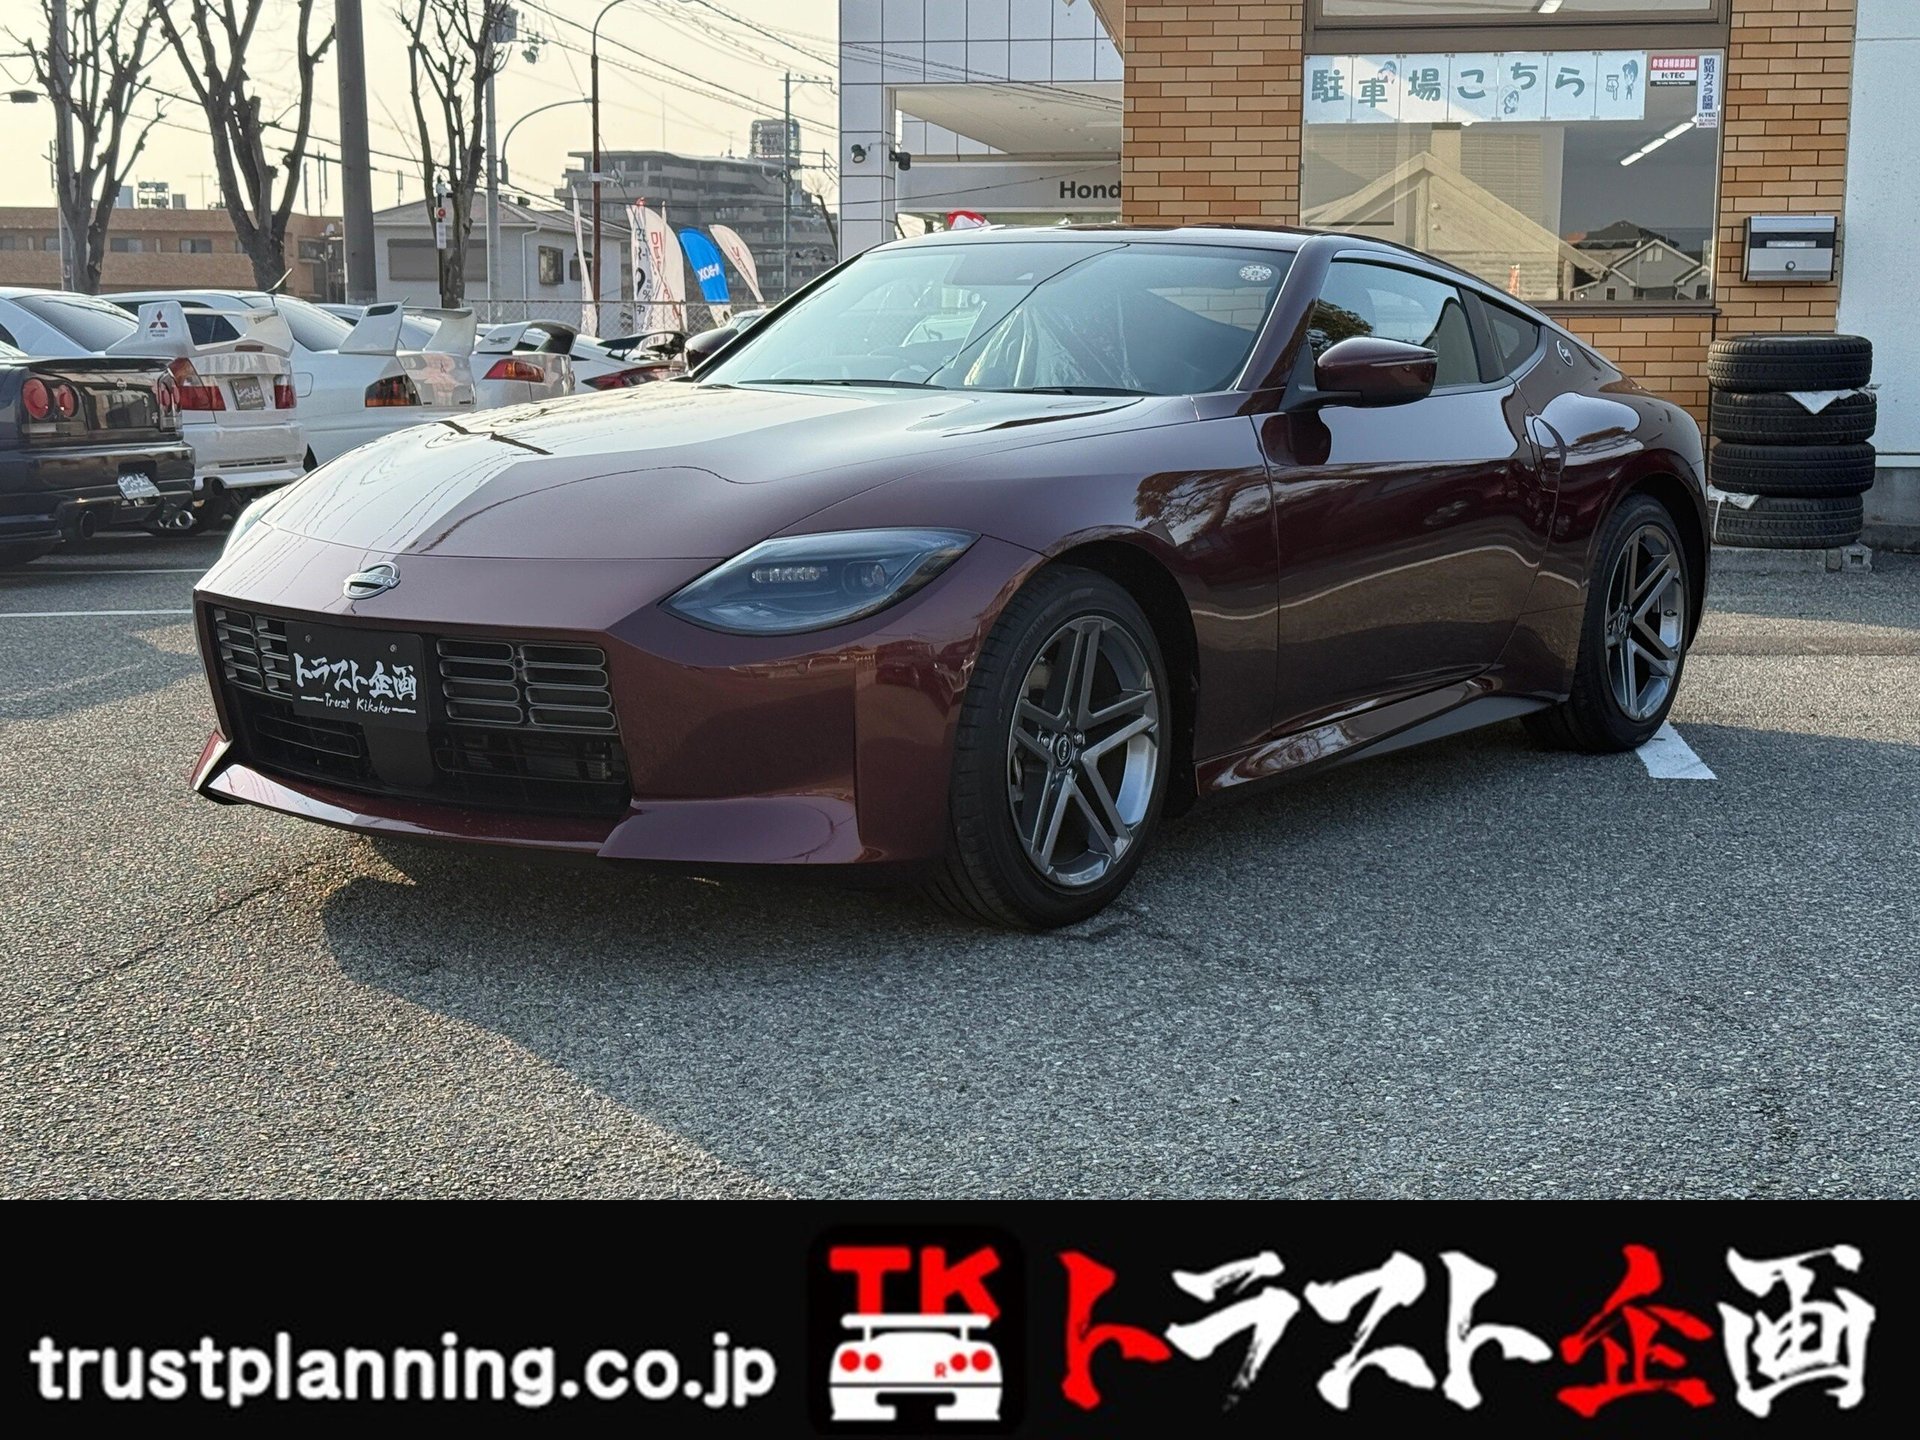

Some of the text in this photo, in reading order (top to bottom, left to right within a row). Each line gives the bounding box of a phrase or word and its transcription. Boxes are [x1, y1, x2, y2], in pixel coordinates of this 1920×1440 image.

[1311, 62, 1586, 108] 駐車場こちら
[1702, 57, 1715, 110] 防犯カメラ設置
[293, 653, 417, 700] トラスト企画
